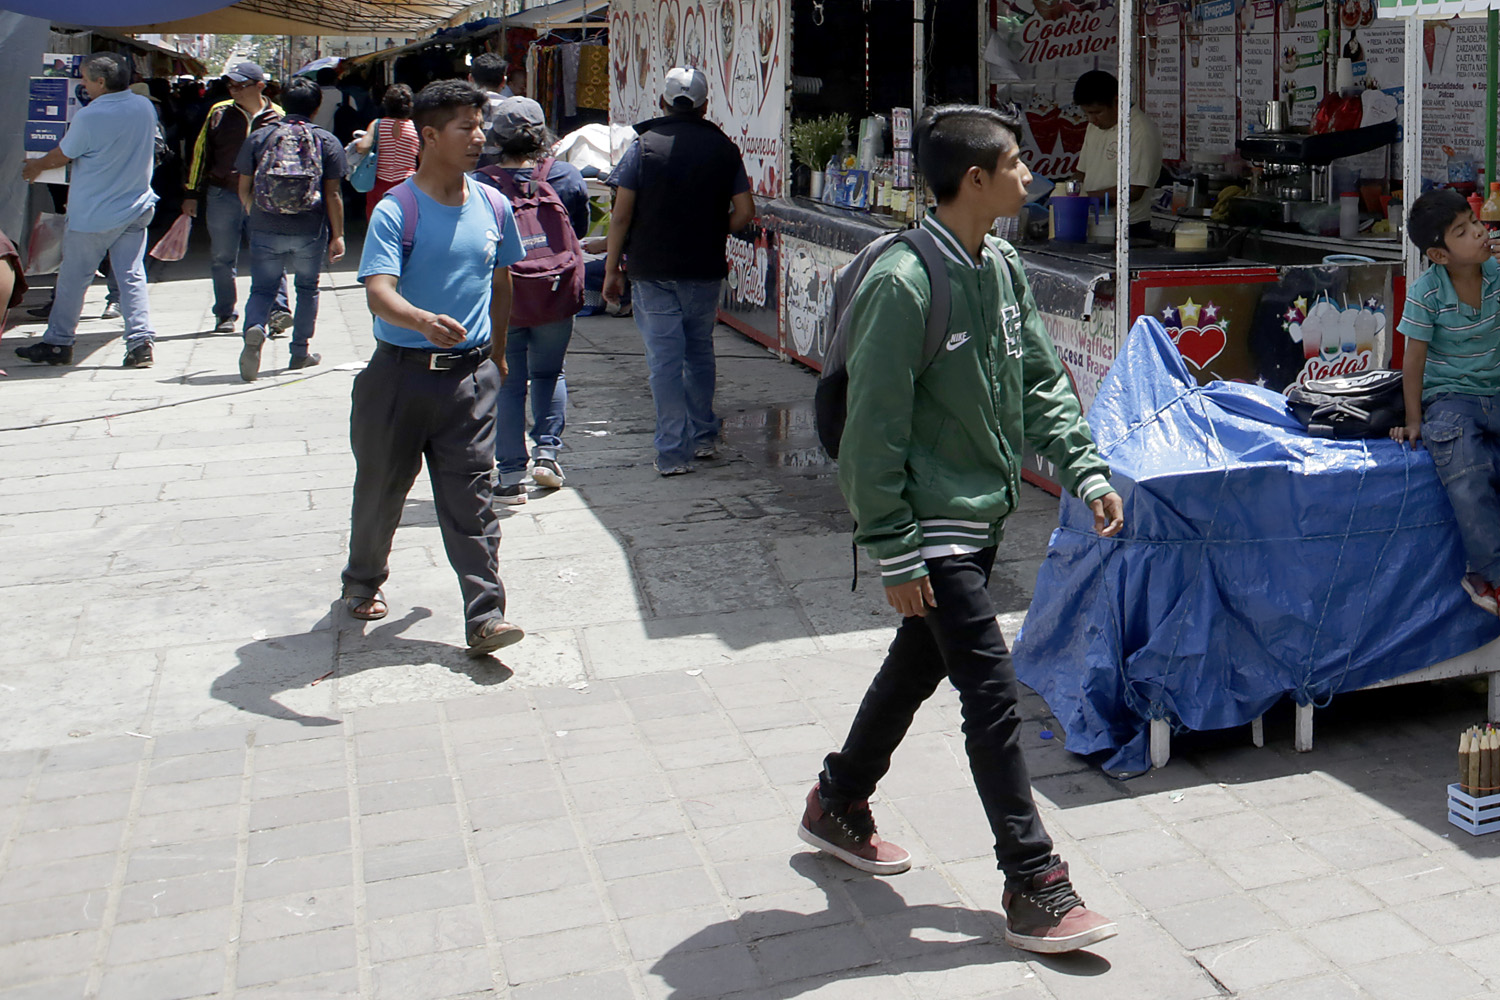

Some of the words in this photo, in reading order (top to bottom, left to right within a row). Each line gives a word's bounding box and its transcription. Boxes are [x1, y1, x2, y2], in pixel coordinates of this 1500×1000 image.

[1023, 13, 1101, 44] Cookie
[1300, 20, 1318, 28] MANGO
[1019, 35, 1117, 64] Monster
[1460, 64, 1475, 72] FRUTA
[951, 331, 968, 343] NIKE
[1078, 331, 1113, 361] Waffles
[1300, 354, 1369, 385] Sodas
